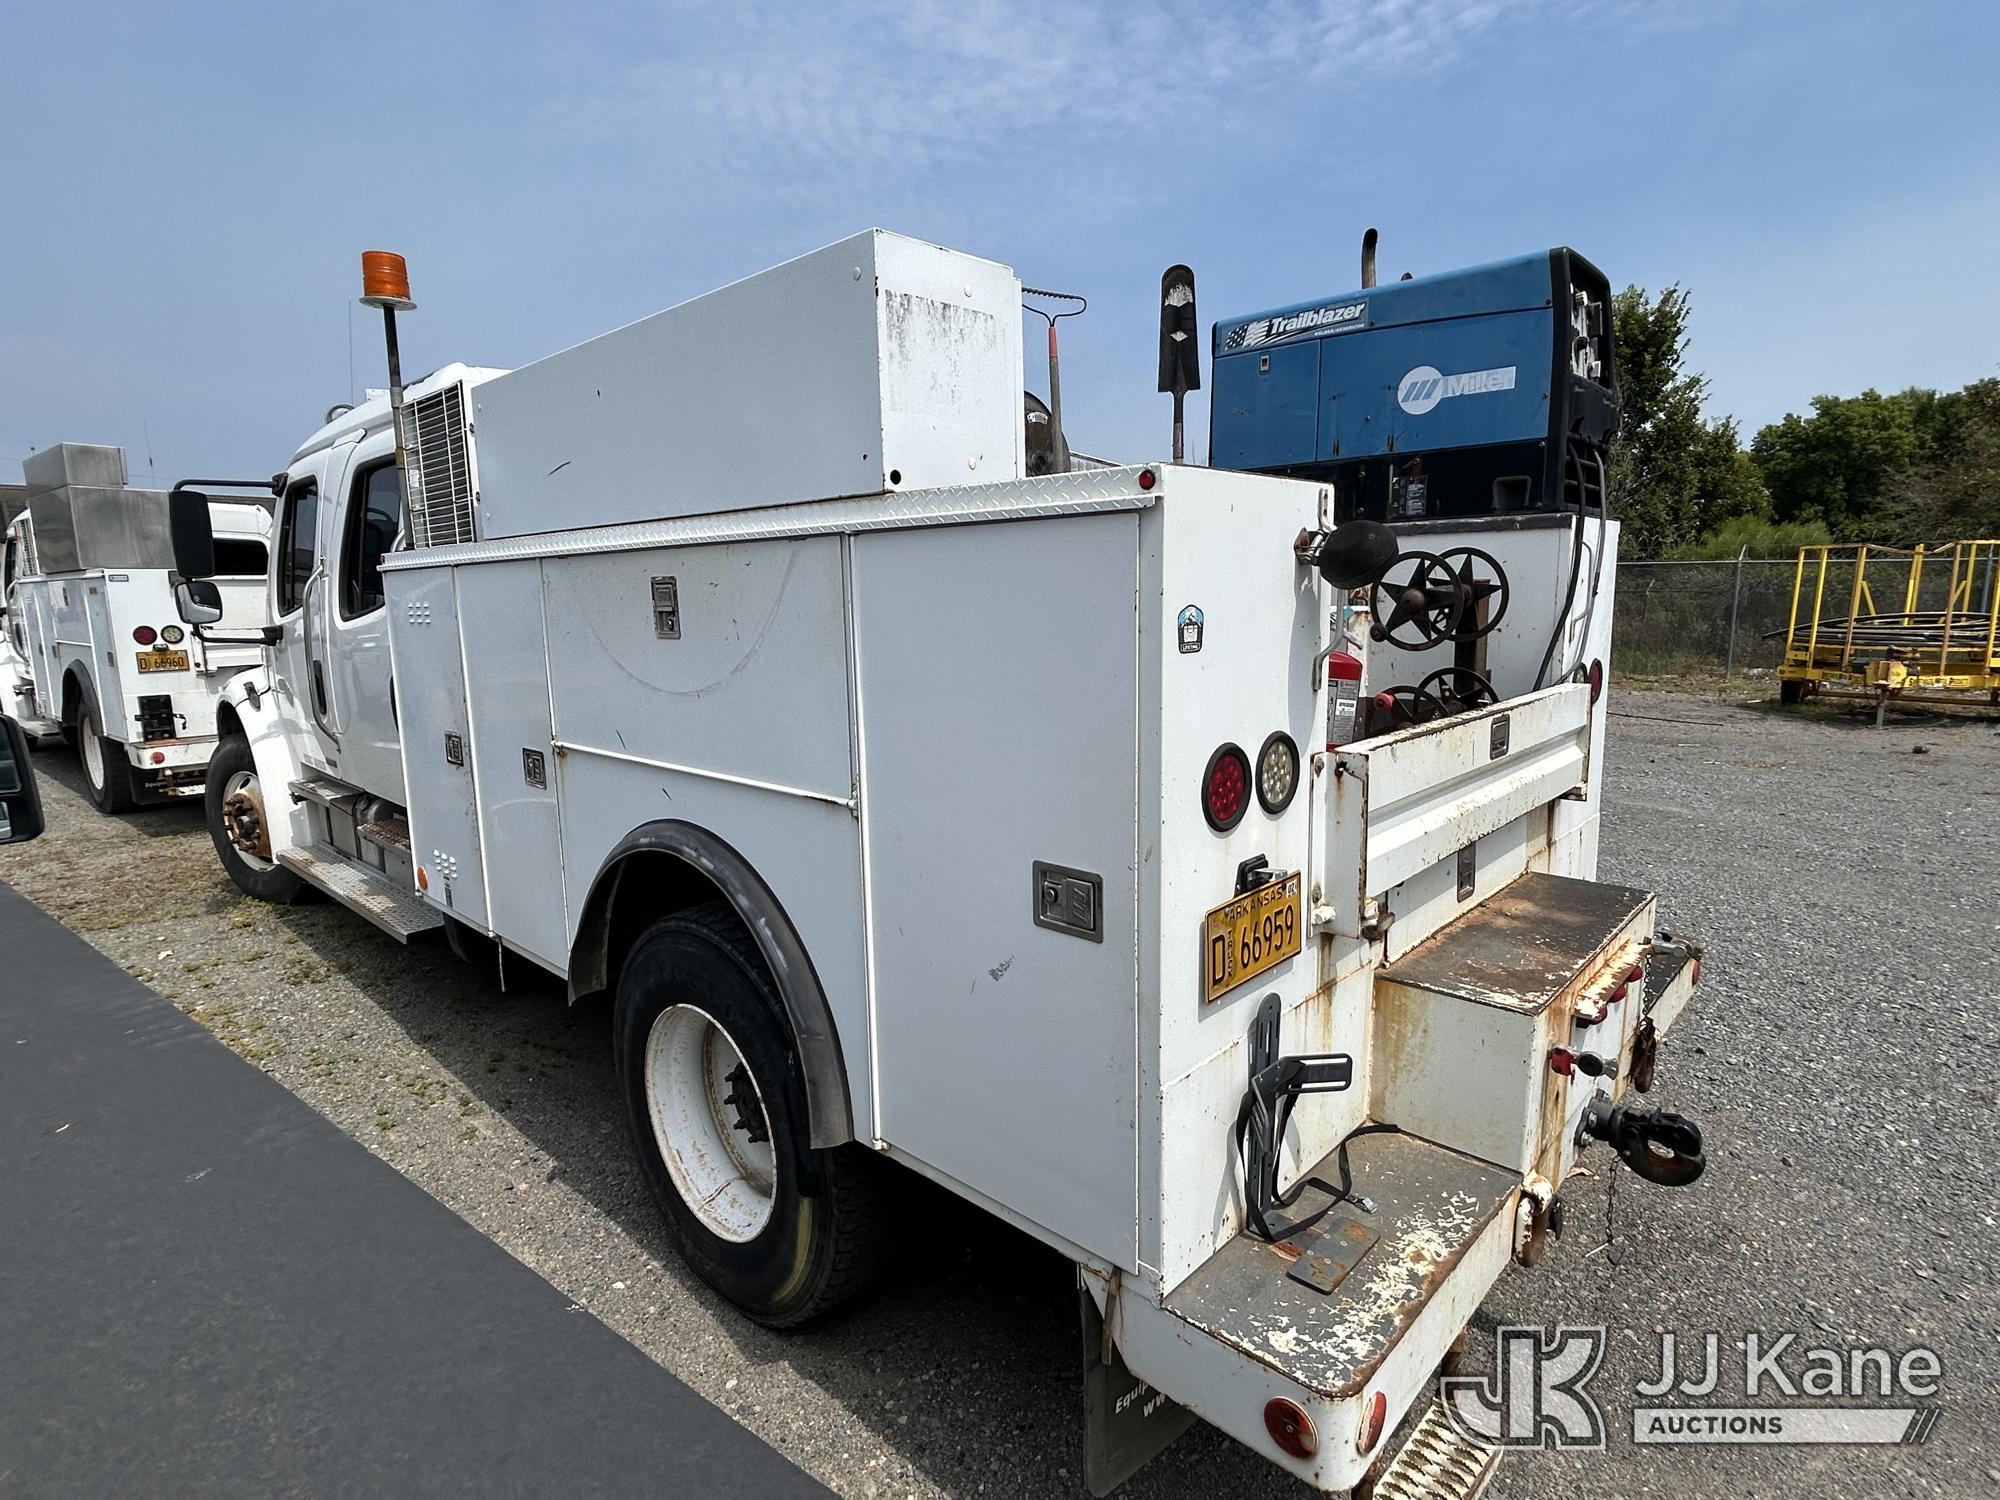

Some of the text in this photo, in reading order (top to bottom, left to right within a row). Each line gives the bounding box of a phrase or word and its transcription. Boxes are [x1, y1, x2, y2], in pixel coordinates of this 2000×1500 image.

[1270, 302, 1366, 334] Trailblazer
[1443, 370, 1513, 396] Miller
[154, 656, 184, 669] 66960
[1228, 886, 1284, 923] ARKANSAS
[1211, 904, 1295, 986] D 66959
[1226, 928, 1234, 978] TRUCK
